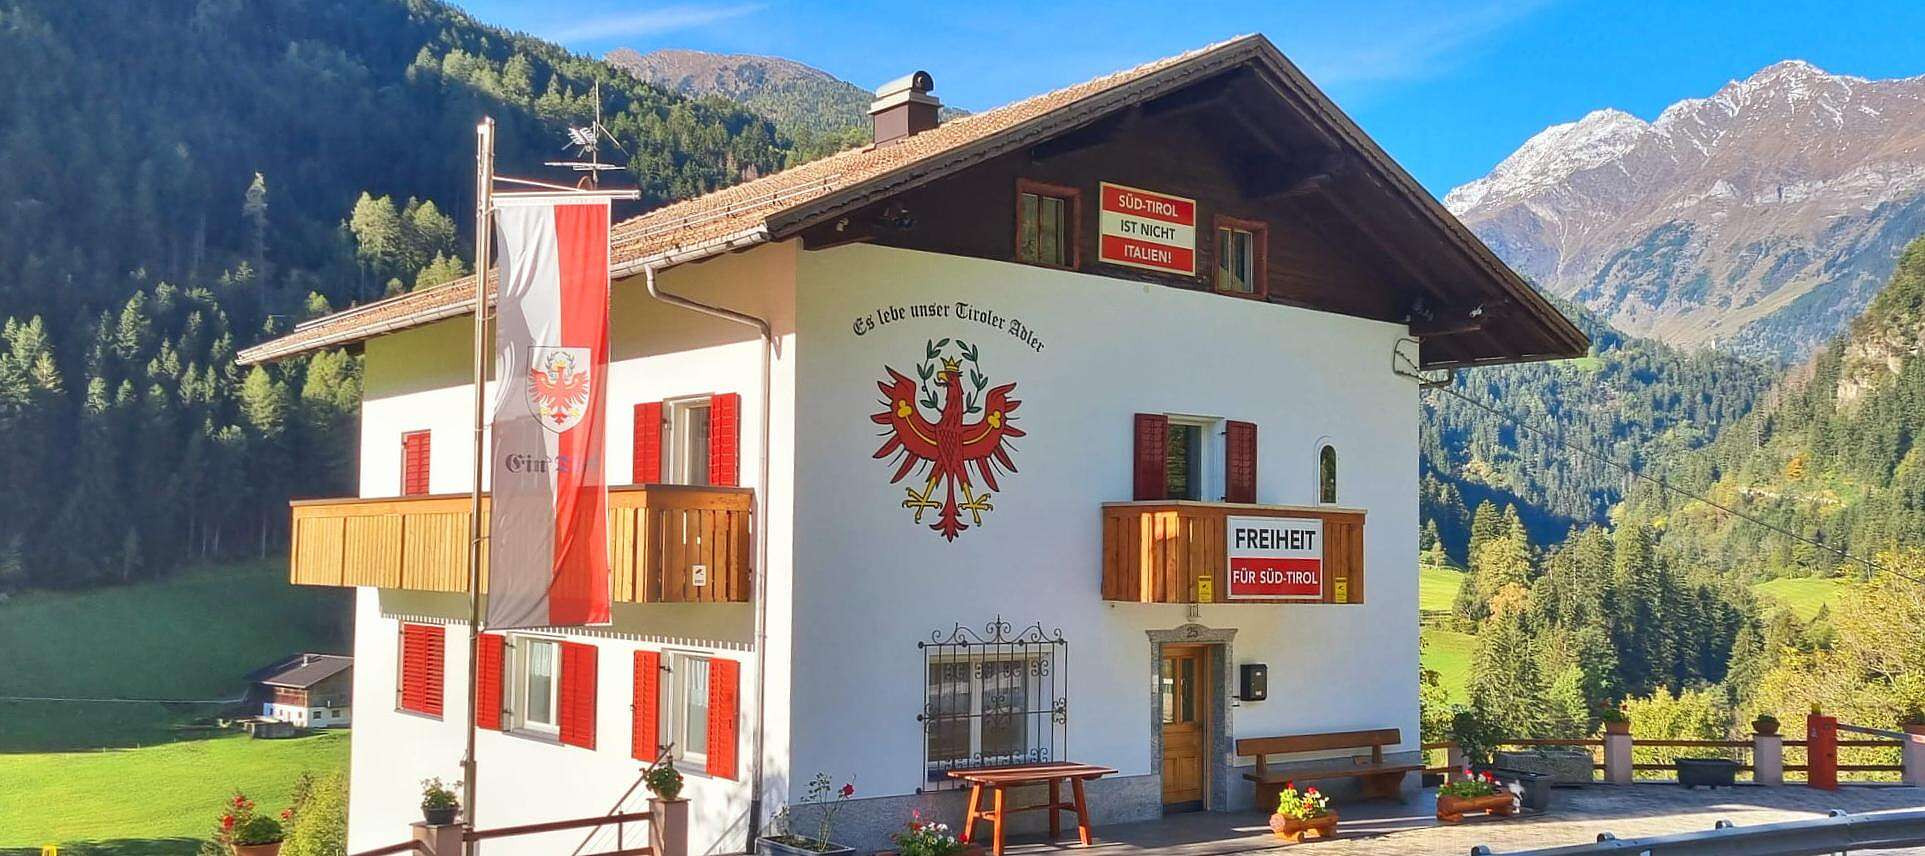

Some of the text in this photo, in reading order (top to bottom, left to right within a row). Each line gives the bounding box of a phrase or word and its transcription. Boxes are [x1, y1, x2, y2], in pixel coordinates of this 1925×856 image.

[1118, 193, 1178, 217] SÜD-TIROL
[1120, 219, 1176, 240] IST NICHT
[1124, 244, 1172, 264] ITALIEN!
[853, 302, 1045, 353] Es lebe unser Tiroler Adler
[1235, 528, 1316, 550] FREIHEIT
[1233, 568, 1319, 585] FÜR SÜD-TIROL
